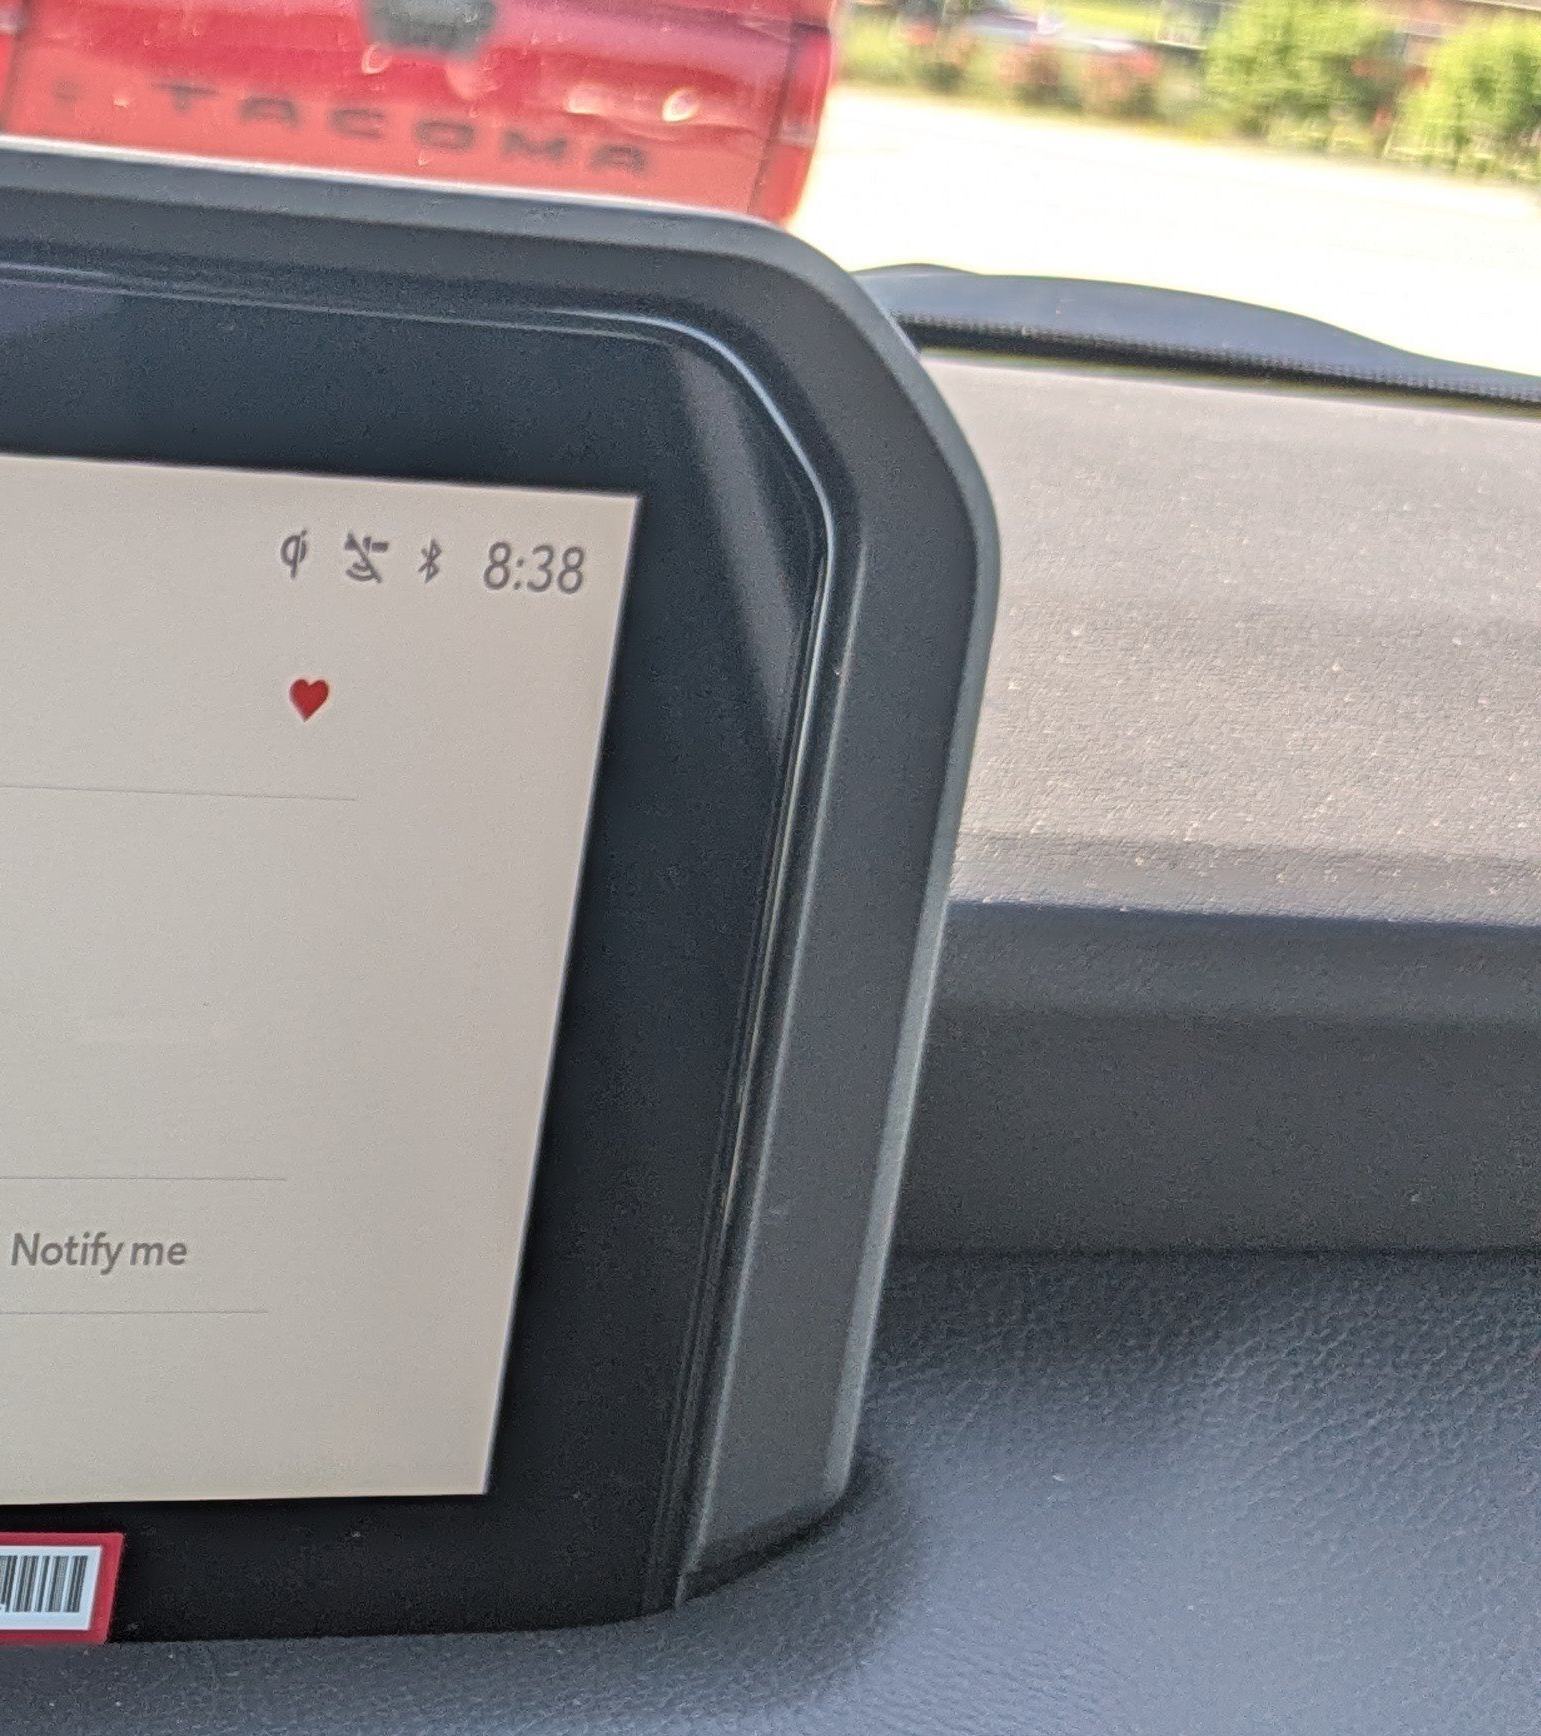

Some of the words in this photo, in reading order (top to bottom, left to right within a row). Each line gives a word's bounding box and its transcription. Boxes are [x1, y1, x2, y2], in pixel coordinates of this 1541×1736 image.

[149, 78, 653, 176] TACOMA
[483, 541, 587, 596] 8:38
[10, 1231, 123, 1277] Notify
[133, 1239, 188, 1270] me
